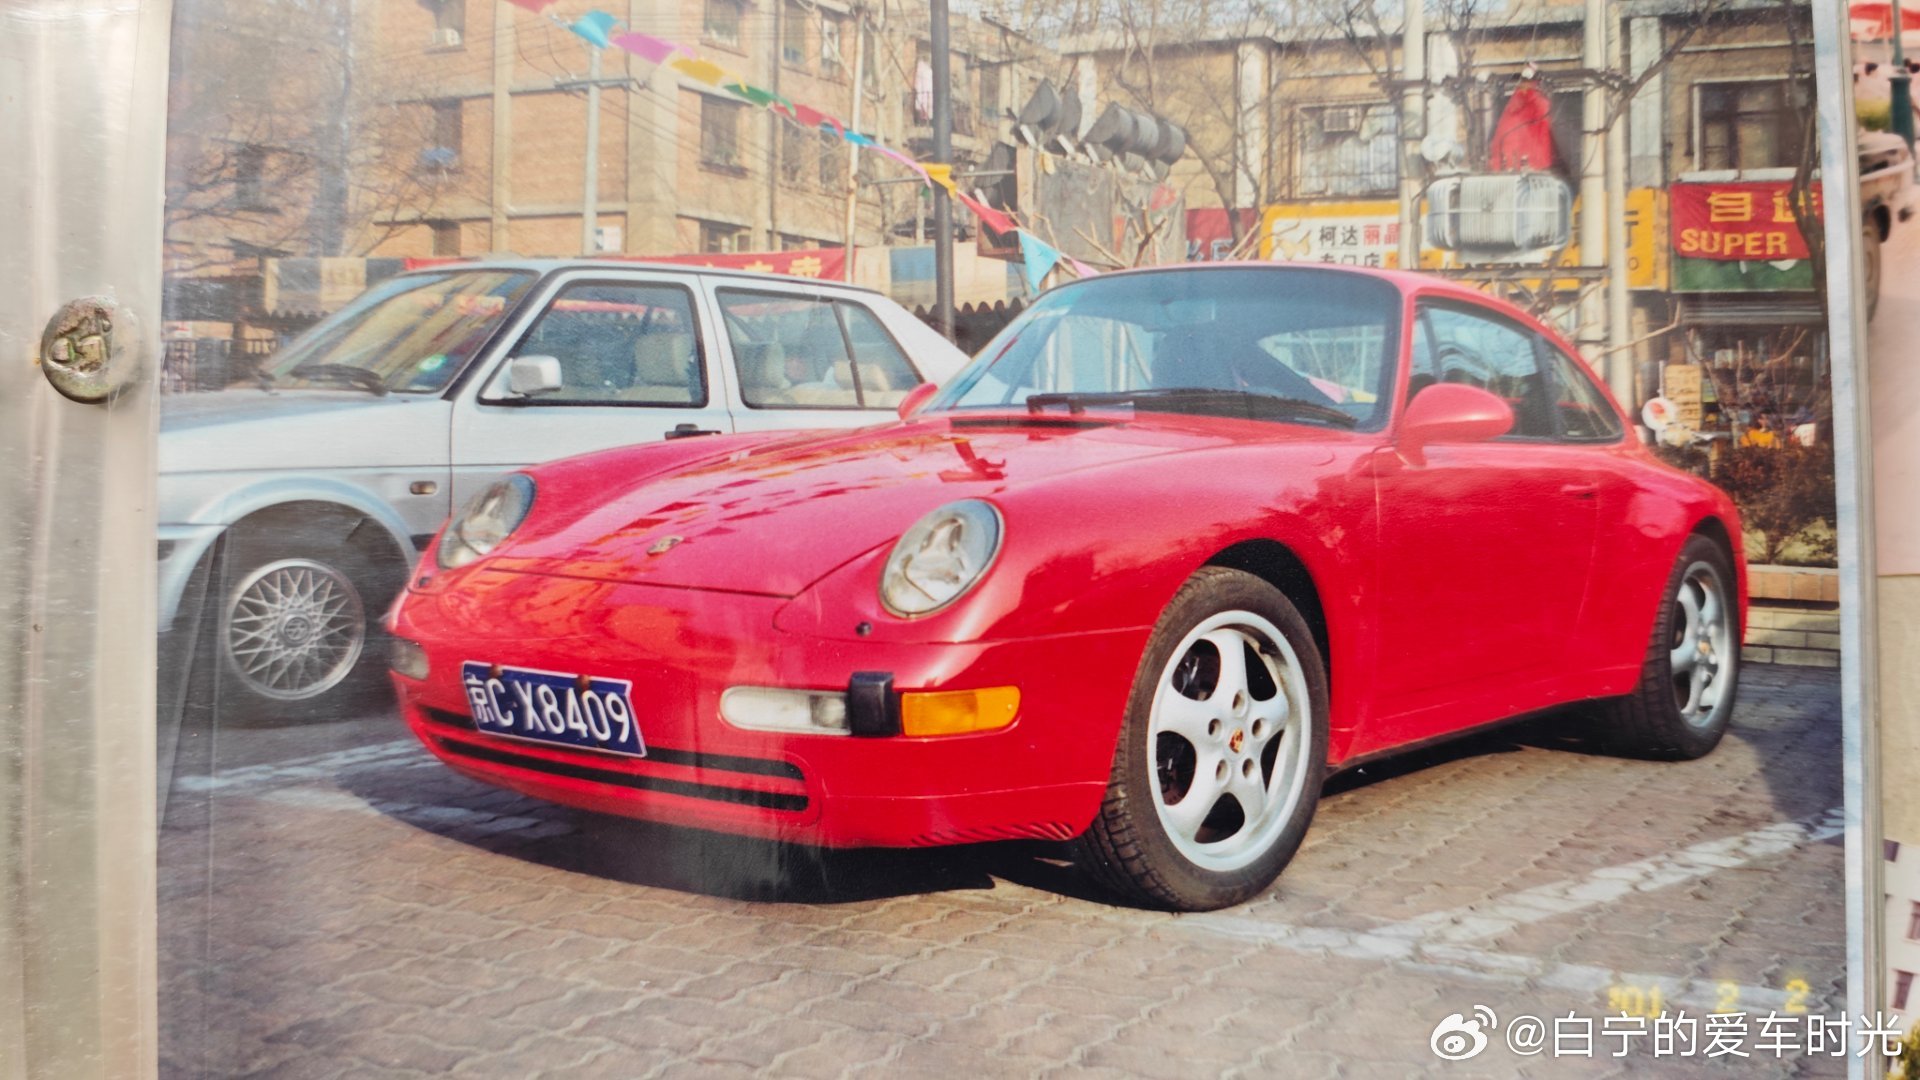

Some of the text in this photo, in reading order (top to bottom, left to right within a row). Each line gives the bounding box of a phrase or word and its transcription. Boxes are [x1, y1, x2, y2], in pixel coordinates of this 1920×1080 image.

[1319, 223, 1400, 247] 柯达丽晶
[1680, 228, 1788, 256] SUPER
